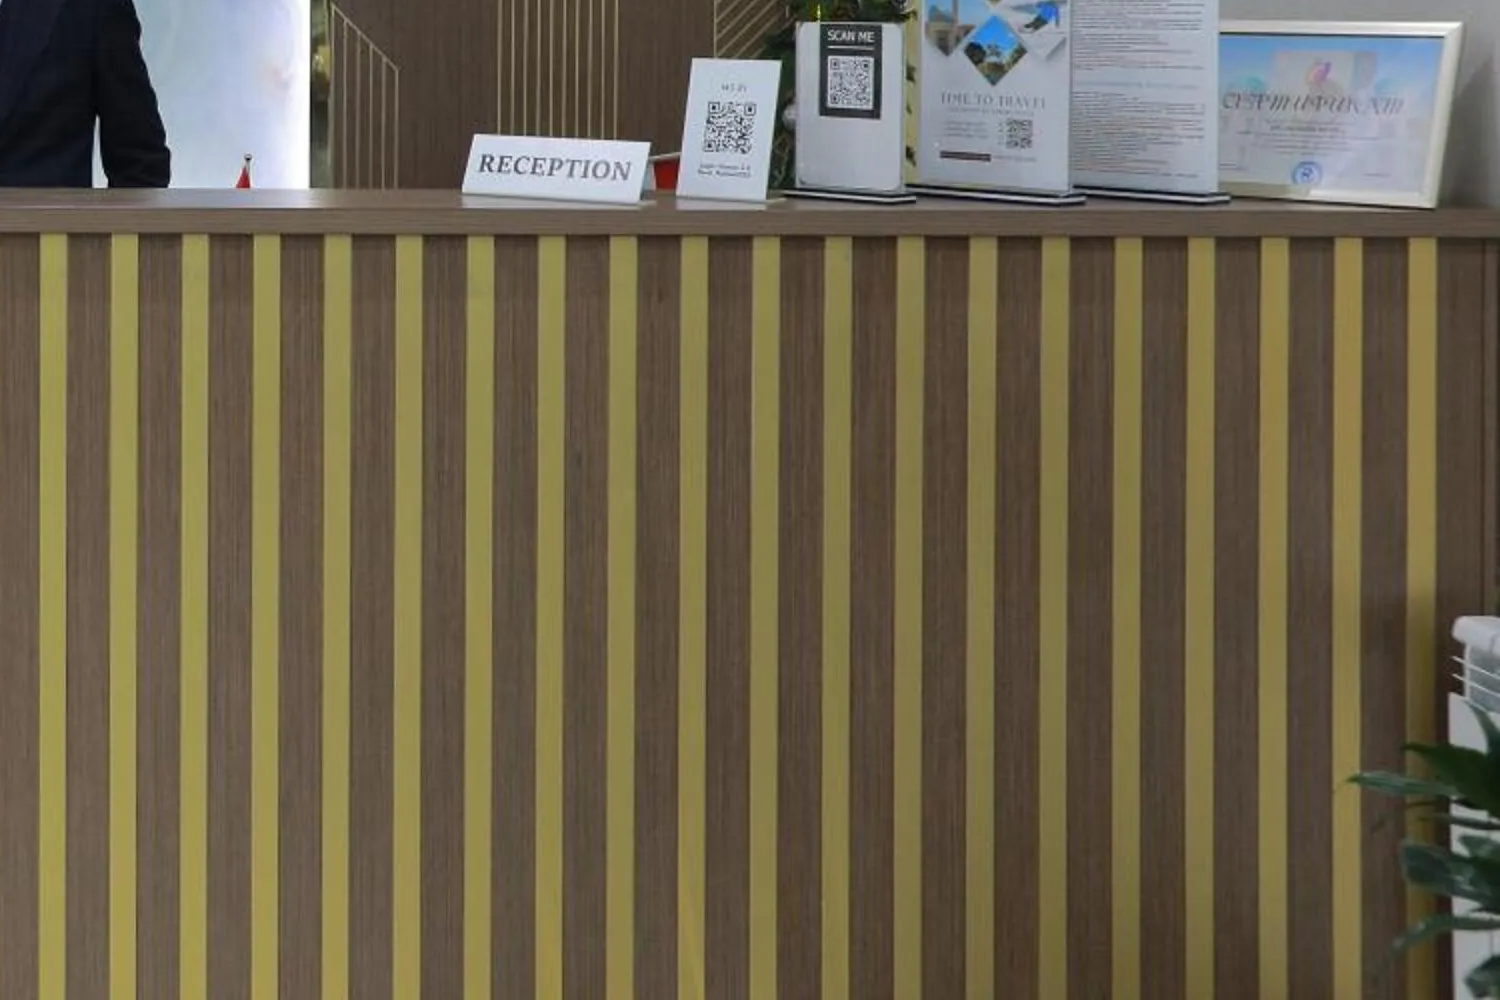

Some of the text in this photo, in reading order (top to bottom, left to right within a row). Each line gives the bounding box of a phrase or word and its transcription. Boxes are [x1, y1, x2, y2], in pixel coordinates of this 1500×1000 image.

[827, 29, 875, 43] SCAN ME
[478, 153, 632, 181] RECEPTION
